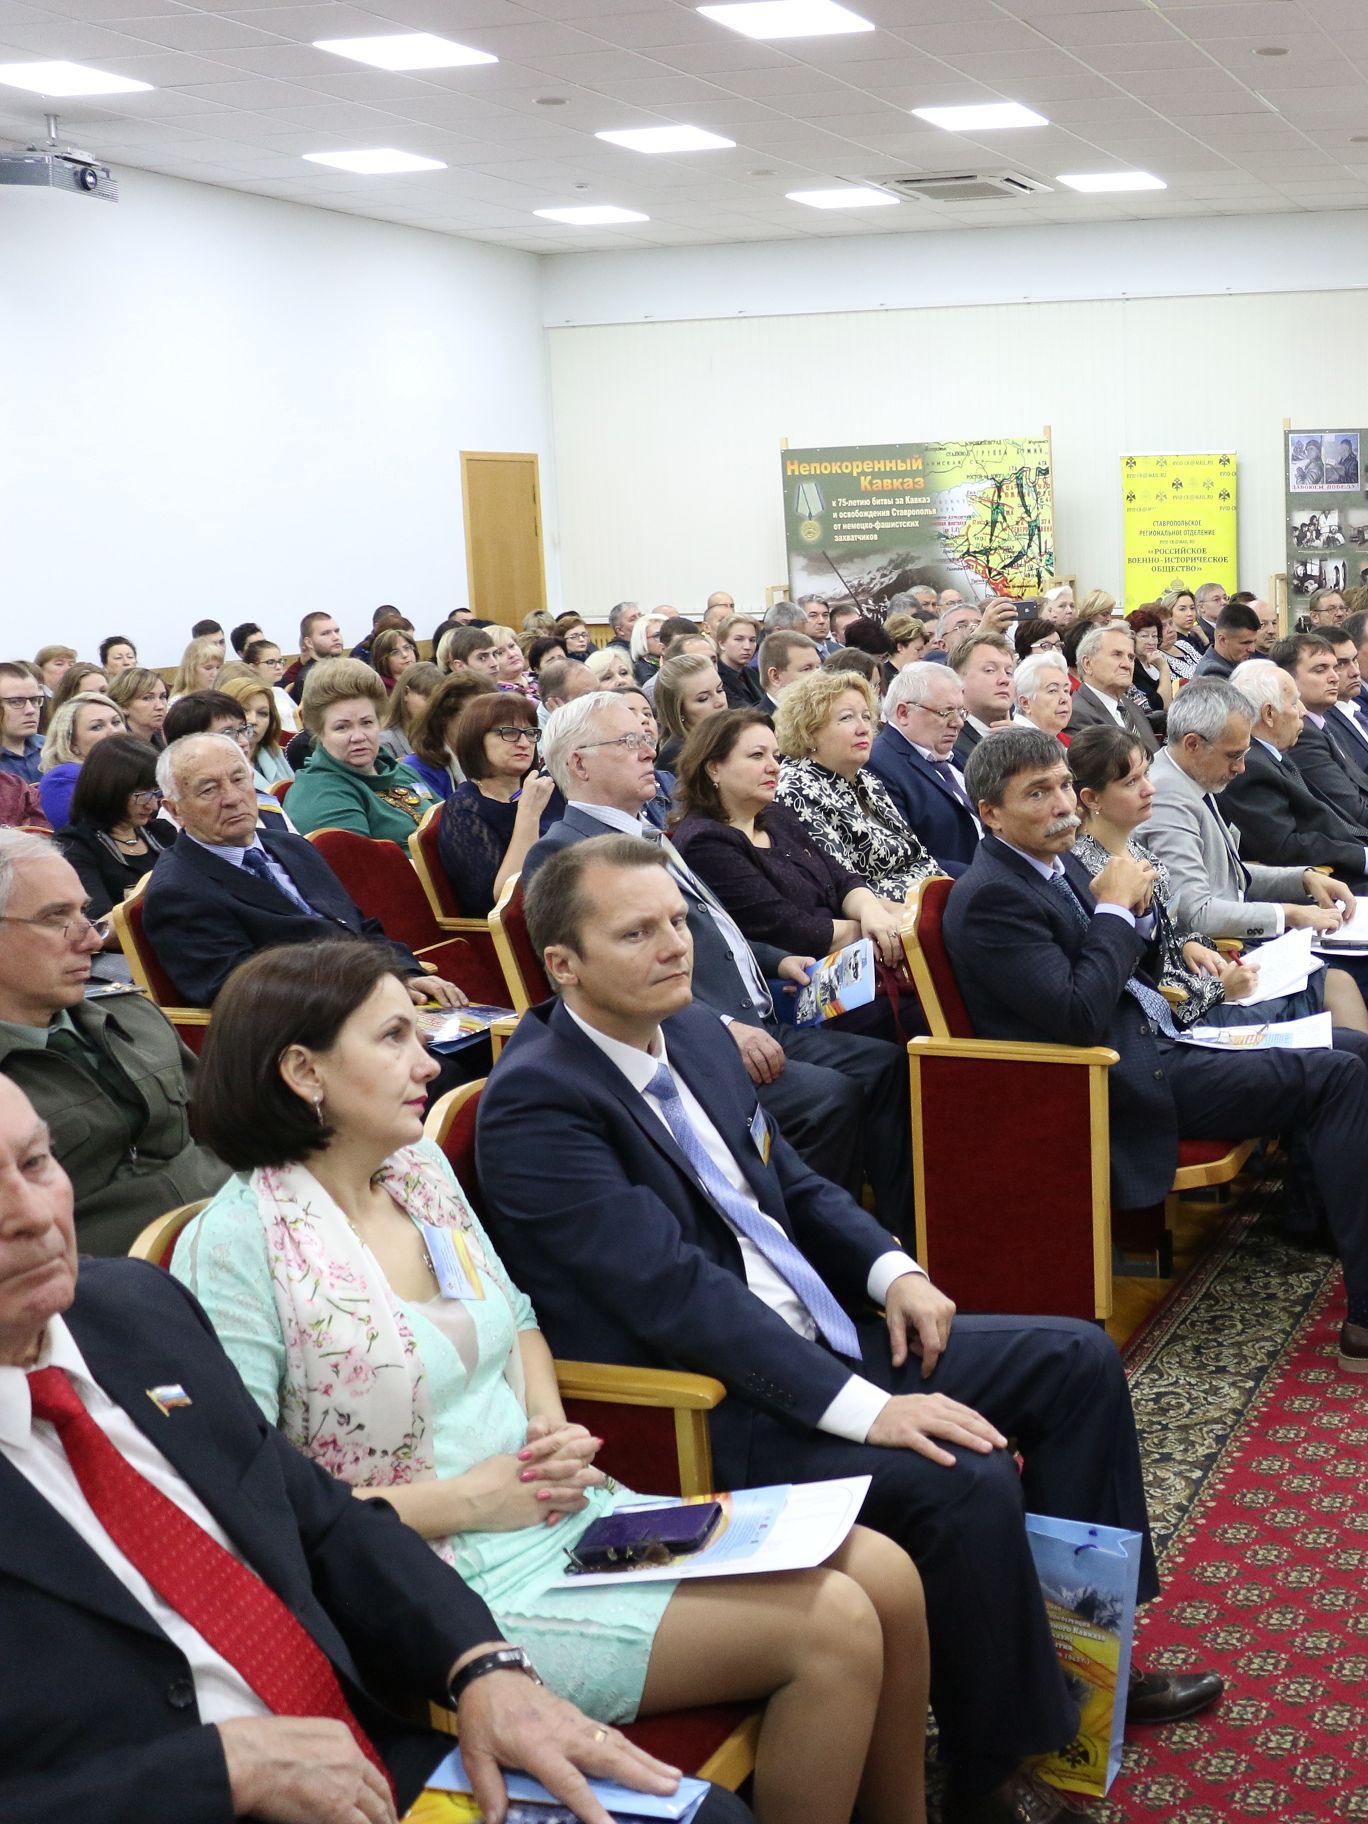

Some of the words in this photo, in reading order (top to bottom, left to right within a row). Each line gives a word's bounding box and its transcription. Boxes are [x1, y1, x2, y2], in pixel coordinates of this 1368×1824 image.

[786, 454, 923, 476] Непокоренный
[860, 475, 926, 491] Кавказ
[837, 498, 871, 507] 75-летию
[871, 496, 894, 506] битвы
[905, 495, 931, 504] Кавказ
[839, 508, 890, 520] освобождения
[891, 507, 937, 518] Ставрополья
[842, 520, 920, 532] немецко-фашистских
[834, 533, 879, 542] захватчиков
[1151, 565, 1202, 573] ОБЩЕСТВО»
